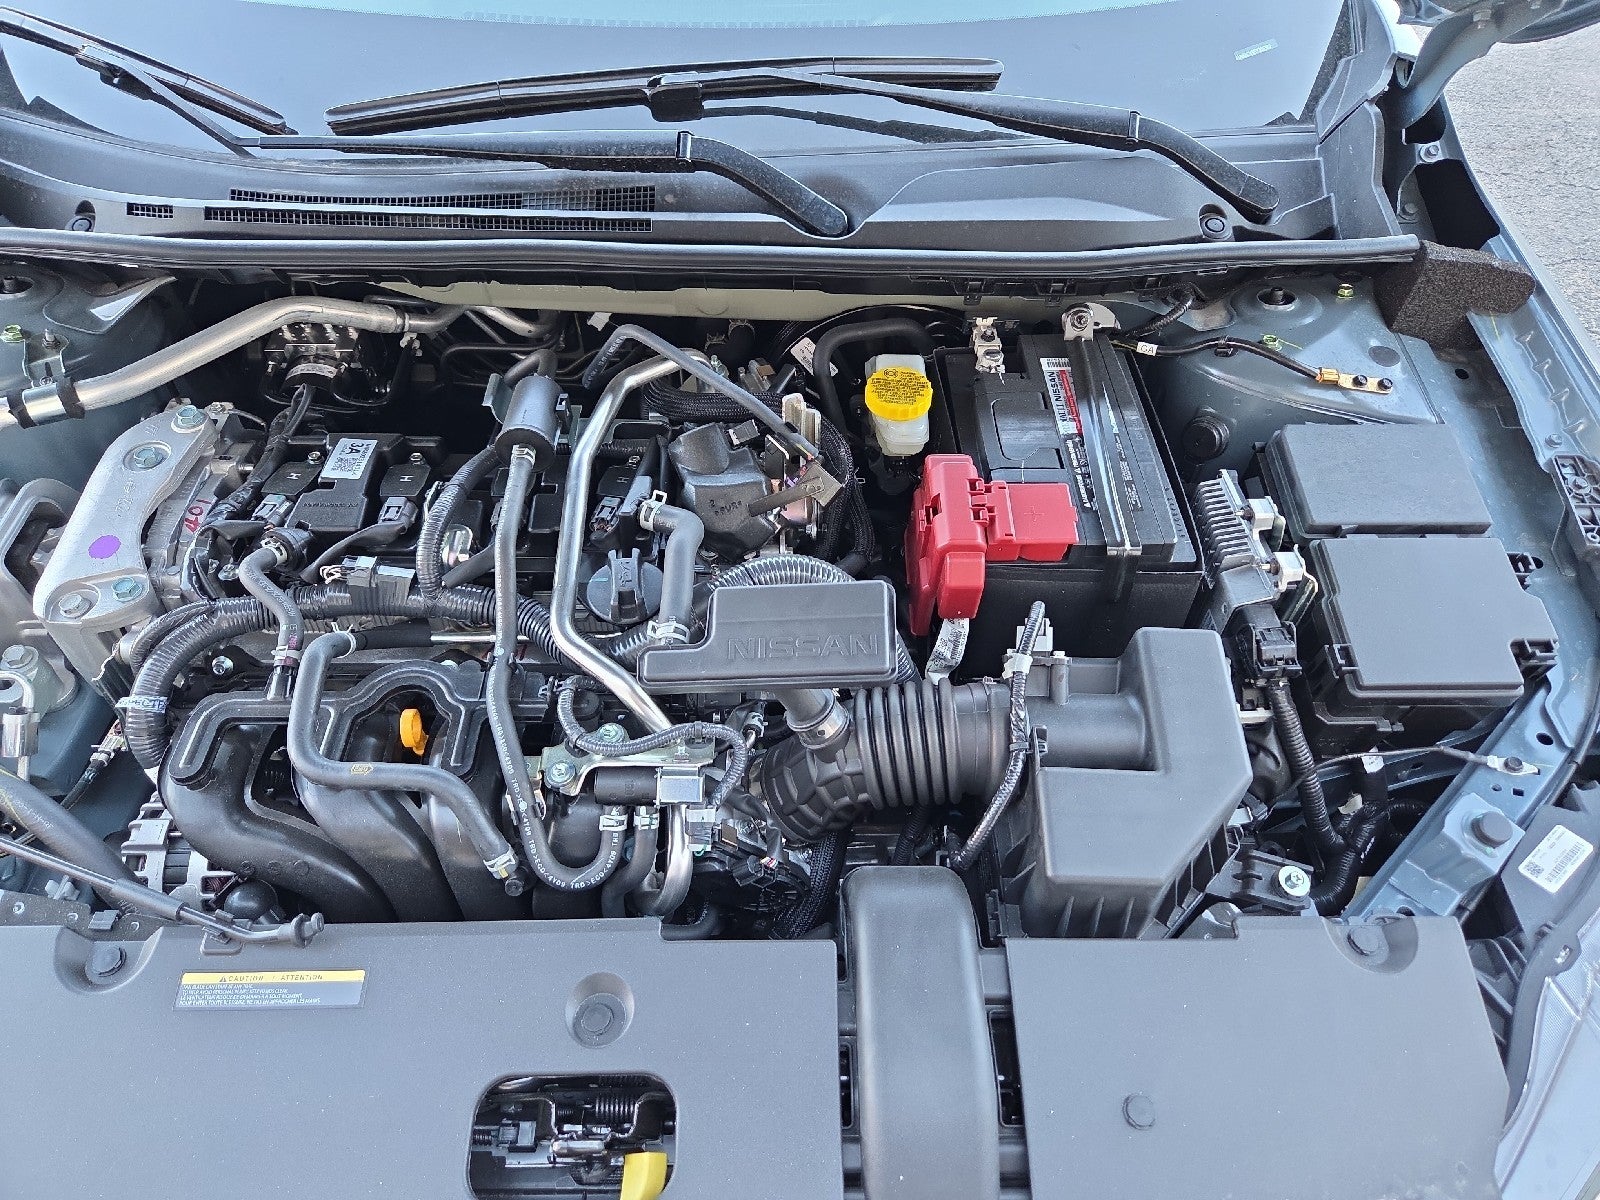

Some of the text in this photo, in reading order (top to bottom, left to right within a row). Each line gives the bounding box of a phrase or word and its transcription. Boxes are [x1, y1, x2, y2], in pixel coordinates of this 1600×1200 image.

[1047, 371, 1063, 402] NISSAN
[345, 442, 365, 455] 3A
[727, 634, 879, 660] NISSAN
